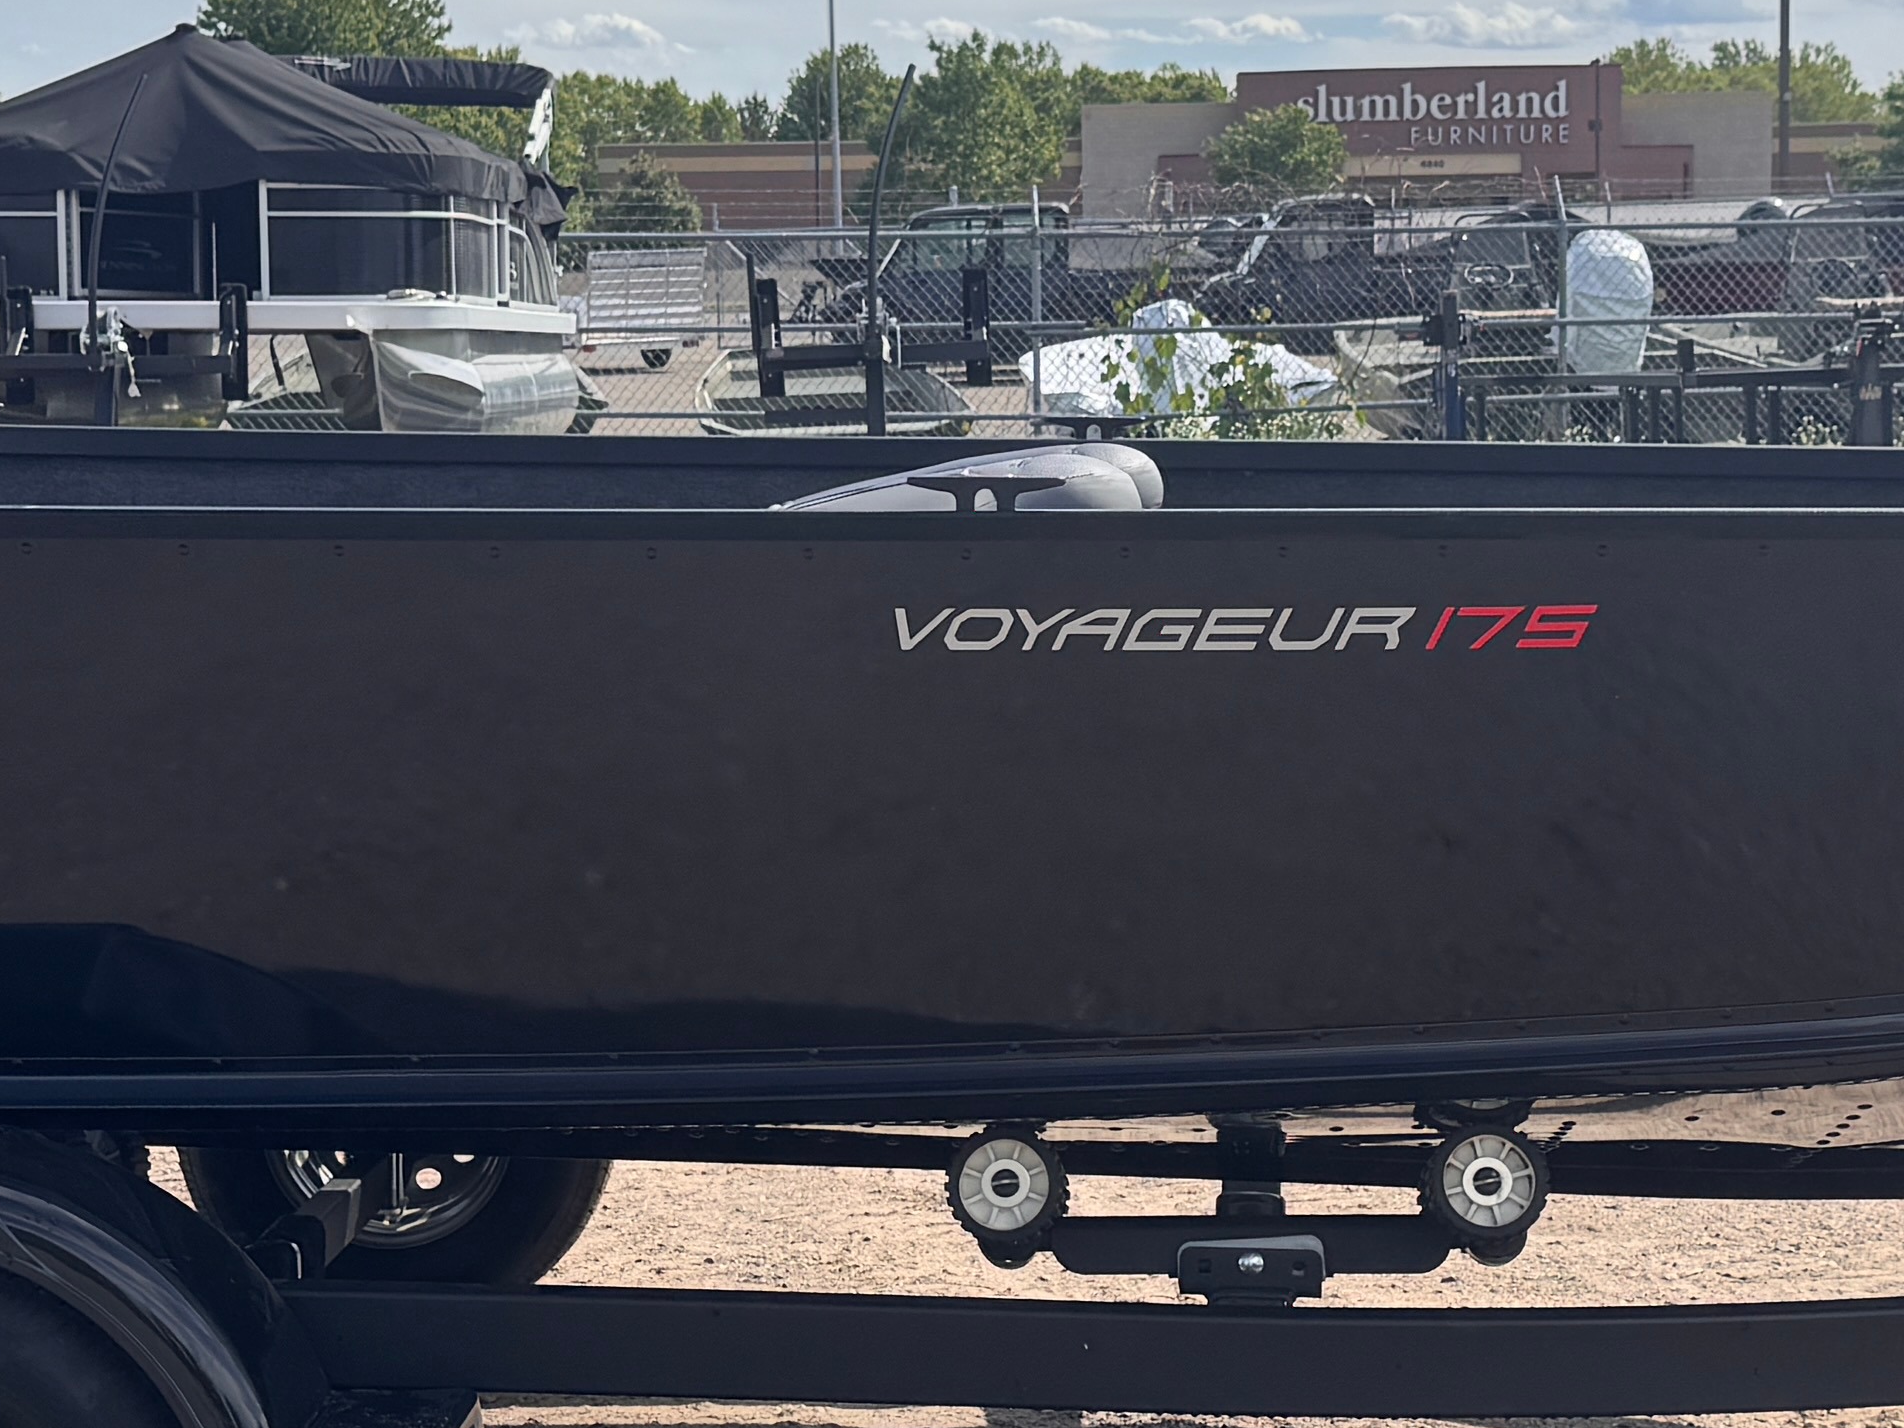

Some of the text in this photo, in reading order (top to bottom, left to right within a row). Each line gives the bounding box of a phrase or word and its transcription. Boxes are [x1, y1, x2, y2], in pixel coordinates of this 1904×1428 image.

[1296, 79, 1569, 122] slumberland
[1411, 124, 1569, 145] FURNITURE
[894, 604, 1598, 652] VOYAGEUR 175
